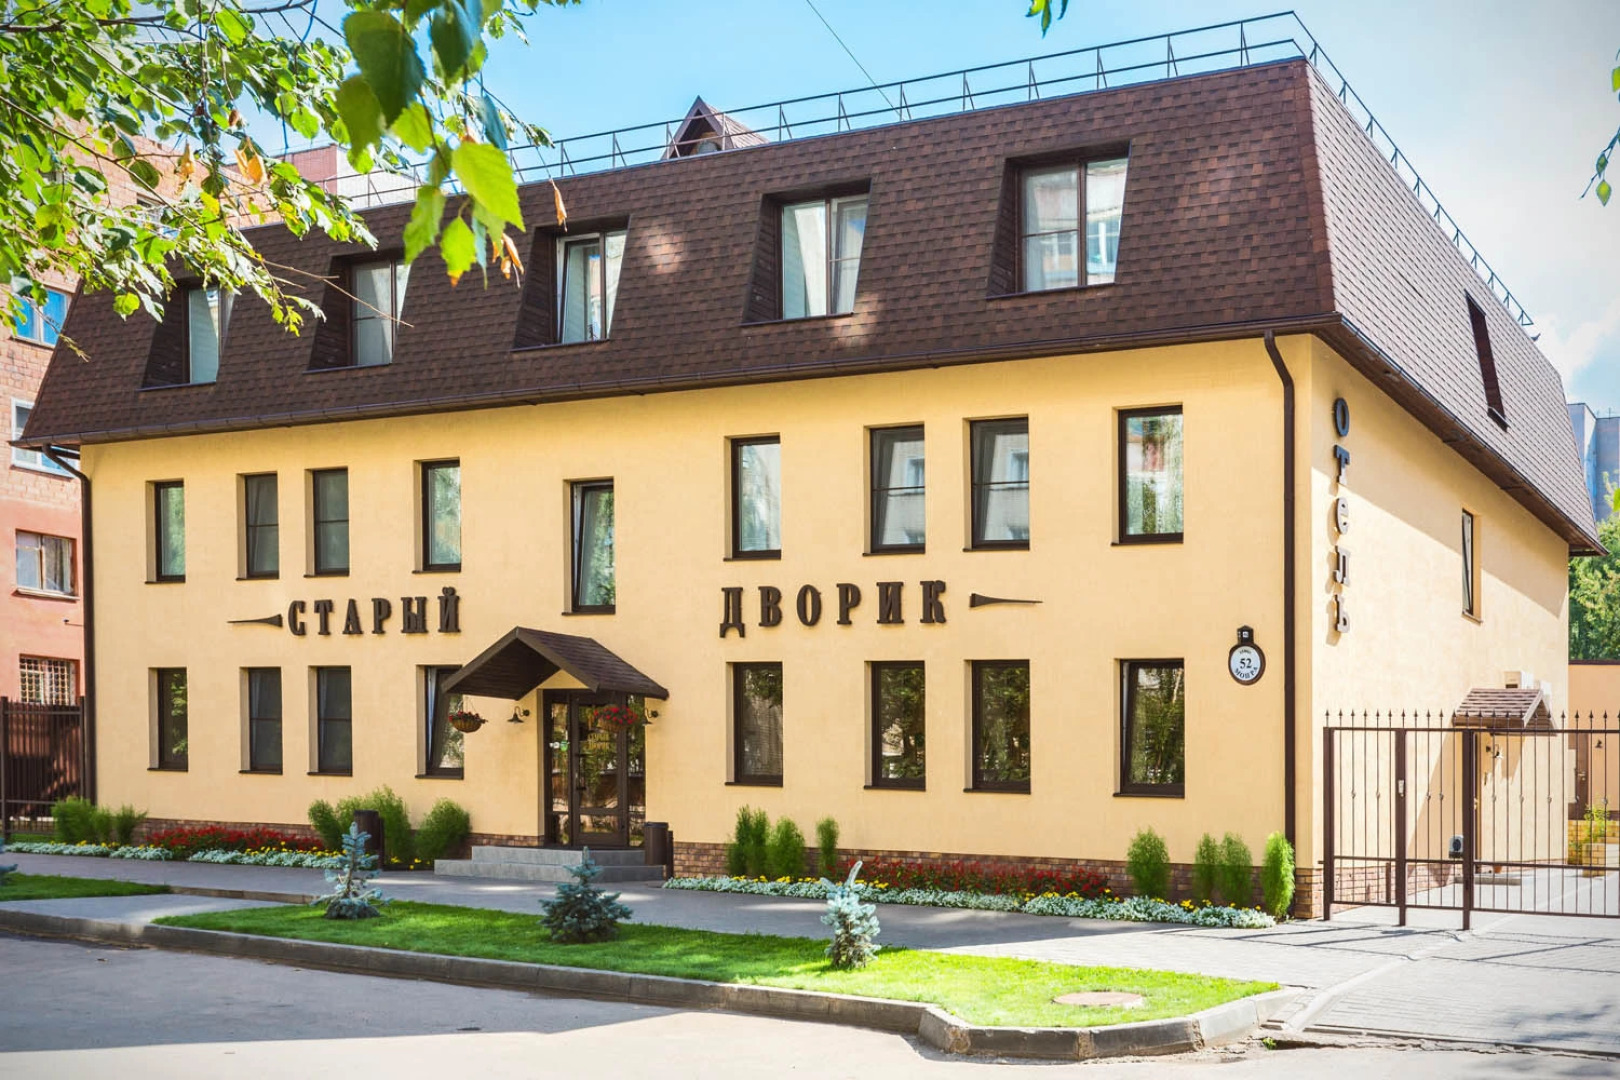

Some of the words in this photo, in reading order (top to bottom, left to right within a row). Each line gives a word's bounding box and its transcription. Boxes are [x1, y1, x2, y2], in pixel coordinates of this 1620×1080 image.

[1333, 397, 1350, 633] ОТЕЛЬ
[287, 587, 461, 636] СТАРЫЙ
[720, 580, 947, 638] ДВОРИК
[1239, 657, 1253, 669] 52
